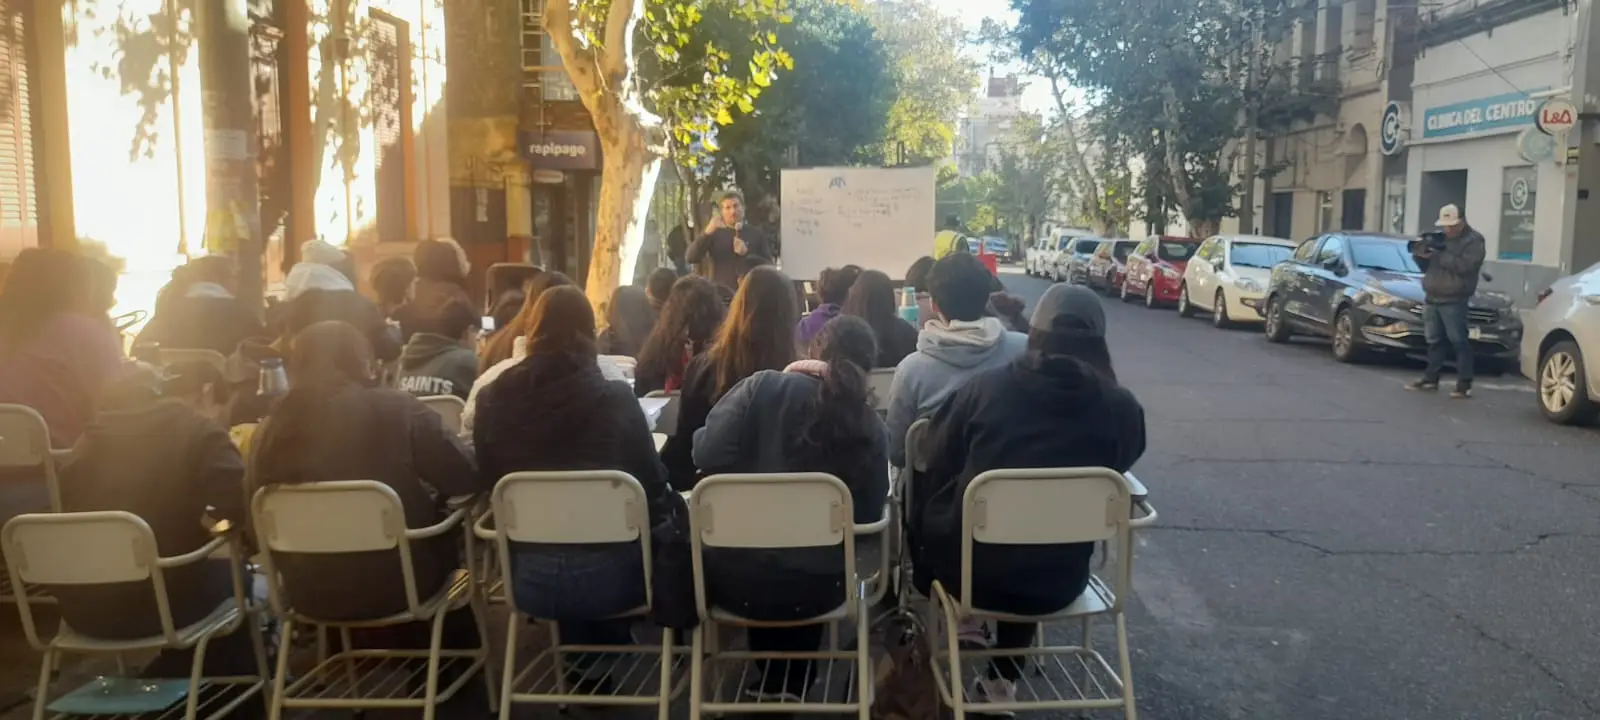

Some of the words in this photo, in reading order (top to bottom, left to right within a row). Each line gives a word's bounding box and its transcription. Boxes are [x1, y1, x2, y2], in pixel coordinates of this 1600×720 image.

[1464, 107, 1483, 125] DEL
[1486, 100, 1536, 121] CENTRO
[529, 142, 586, 157] rapipago
[401, 375, 453, 393] SAINTS
